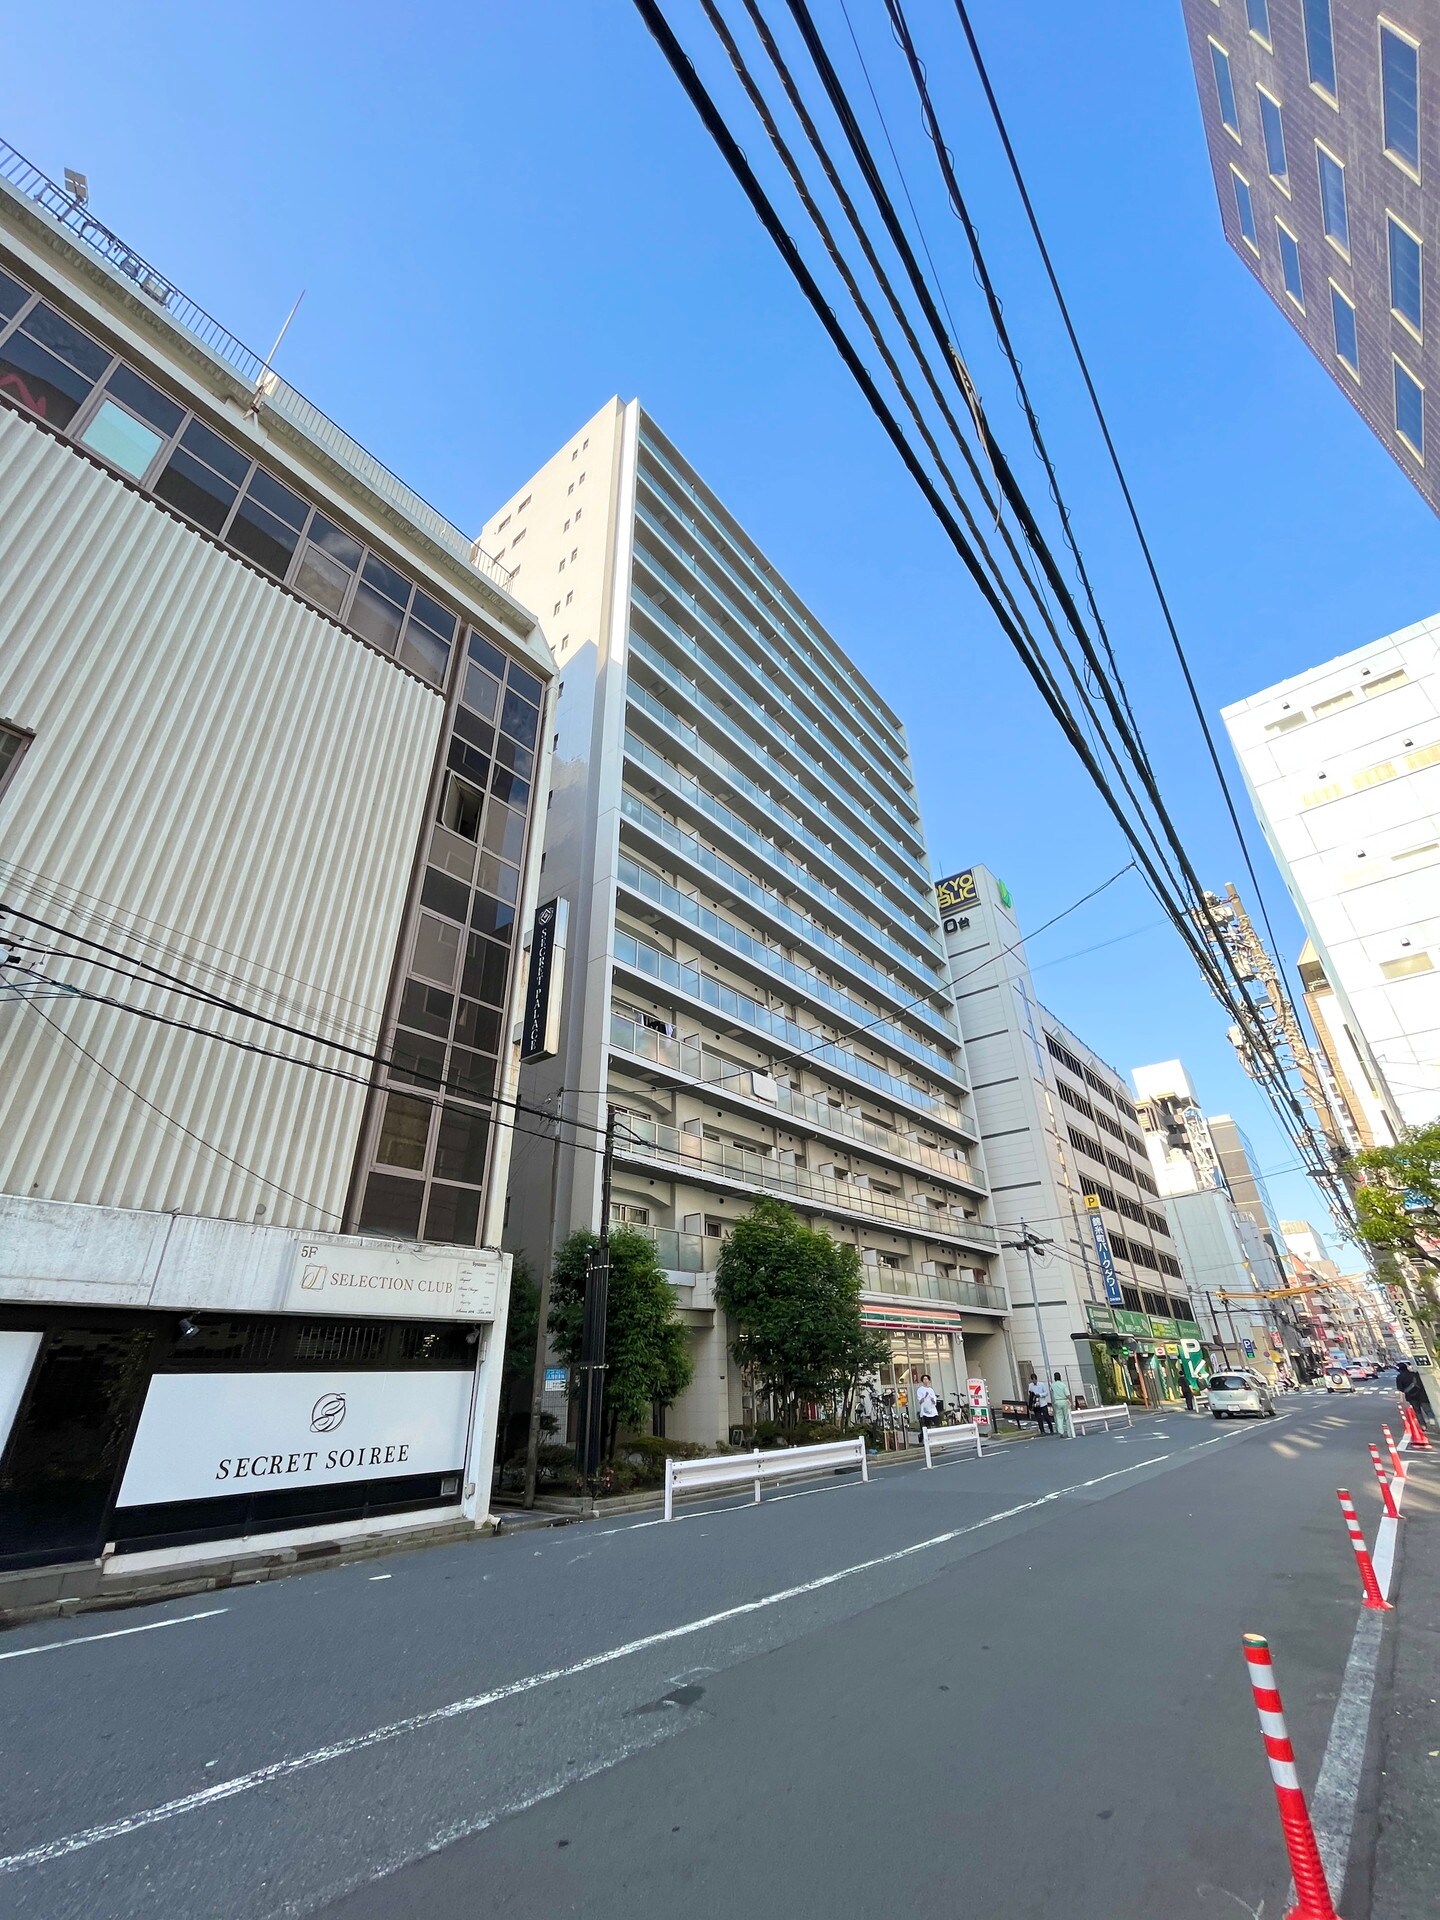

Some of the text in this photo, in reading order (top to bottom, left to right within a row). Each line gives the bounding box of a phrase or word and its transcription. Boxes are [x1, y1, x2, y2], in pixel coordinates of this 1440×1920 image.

[530, 928, 547, 1051] SECRET PALACE
[1087, 1197, 1095, 1206] P
[301, 1246, 318, 1259] 5F
[330, 1273, 414, 1291] SELECTION
[417, 1280, 453, 1294] CLUB
[1180, 1338, 1200, 1359] P
[1243, 1340, 1252, 1349] P
[215, 1444, 410, 1480] SECRET SOIREE
